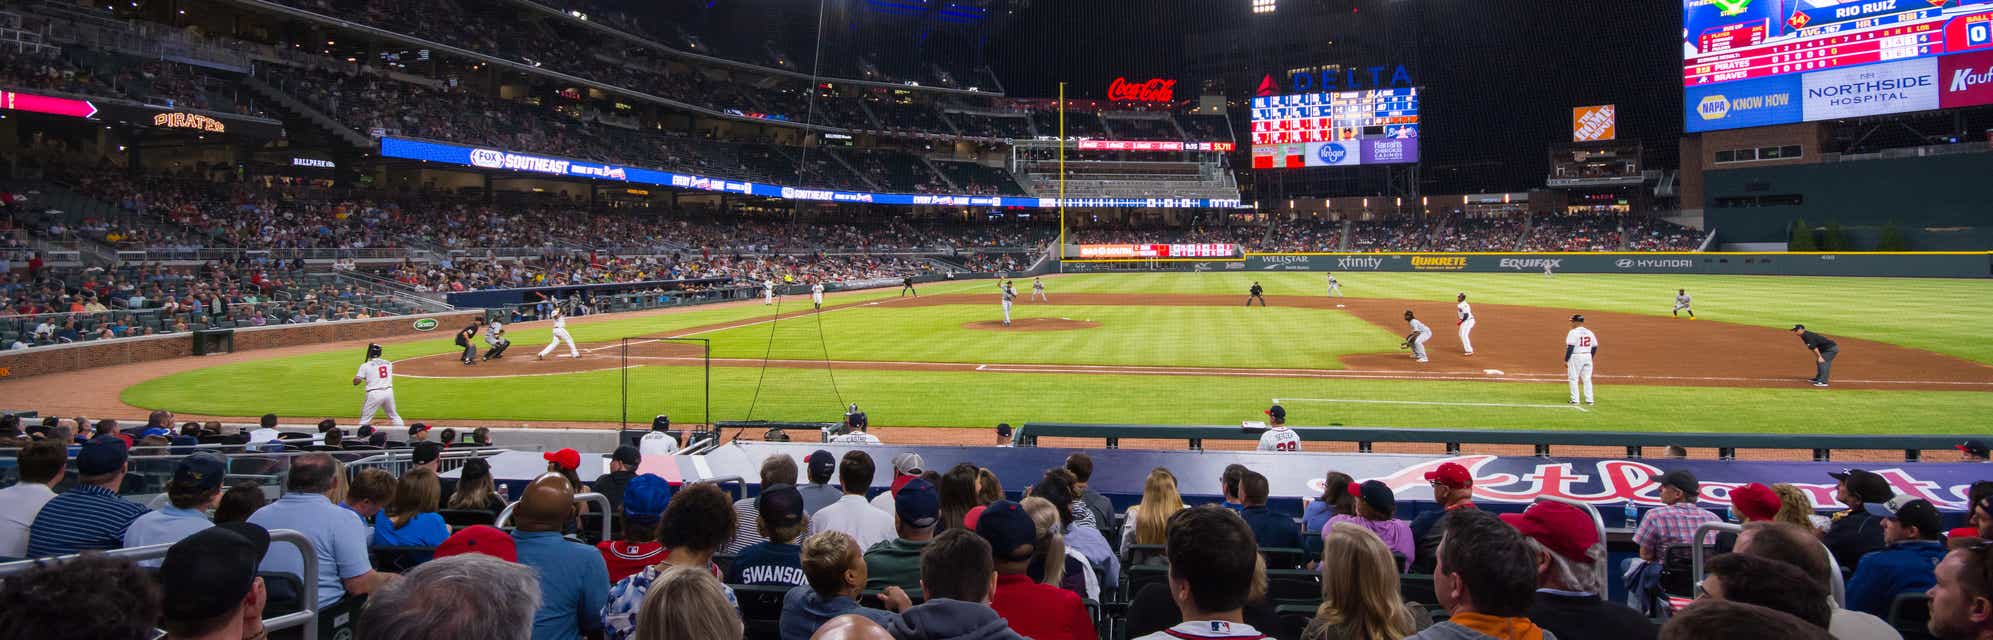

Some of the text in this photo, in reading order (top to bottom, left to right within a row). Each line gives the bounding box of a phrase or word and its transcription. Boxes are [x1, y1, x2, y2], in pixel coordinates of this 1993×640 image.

[1836, 0, 1896, 18] RIO RUIZ
[1791, 15, 1805, 26] 14
[1801, 28, 1820, 38] AVG
[1821, 25, 1841, 35] .167
[1856, 20, 1871, 29] HR
[1898, 12, 1917, 22] RBI
[1966, 15, 1987, 23] BALL
[1970, 26, 1987, 42] 0
[1714, 60, 1749, 71] PIRATES
[1293, 64, 1412, 91] DELTA
[1714, 71, 1747, 82] BRAVES
[1809, 75, 1932, 98] NORTHSIDE
[1255, 98, 1267, 108] NL
[1733, 93, 1789, 110] KNOW HOW
[1830, 92, 1908, 106] HOSPITAL
[1702, 101, 1726, 114] NAPA
[154, 112, 224, 133] PIRATES
[1574, 104, 1614, 141] HOME
[1578, 110, 1594, 125] THE
[1590, 116, 1614, 140] DEPOT
[1320, 145, 1345, 161] Kroger
[294, 157, 326, 168] BALLPARK
[478, 150, 497, 163] FOX
[505, 153, 570, 175] SOUTHEAST
[1262, 255, 1310, 264] WELLSTAR
[1338, 255, 1383, 270] xfinity
[1410, 255, 1467, 266] QUIKRETE
[1500, 258, 1562, 270] EQUIFAX
[1637, 259, 1693, 268] HYUNDAI
[1579, 336, 1591, 347] 12
[378, 366, 388, 379] 8
